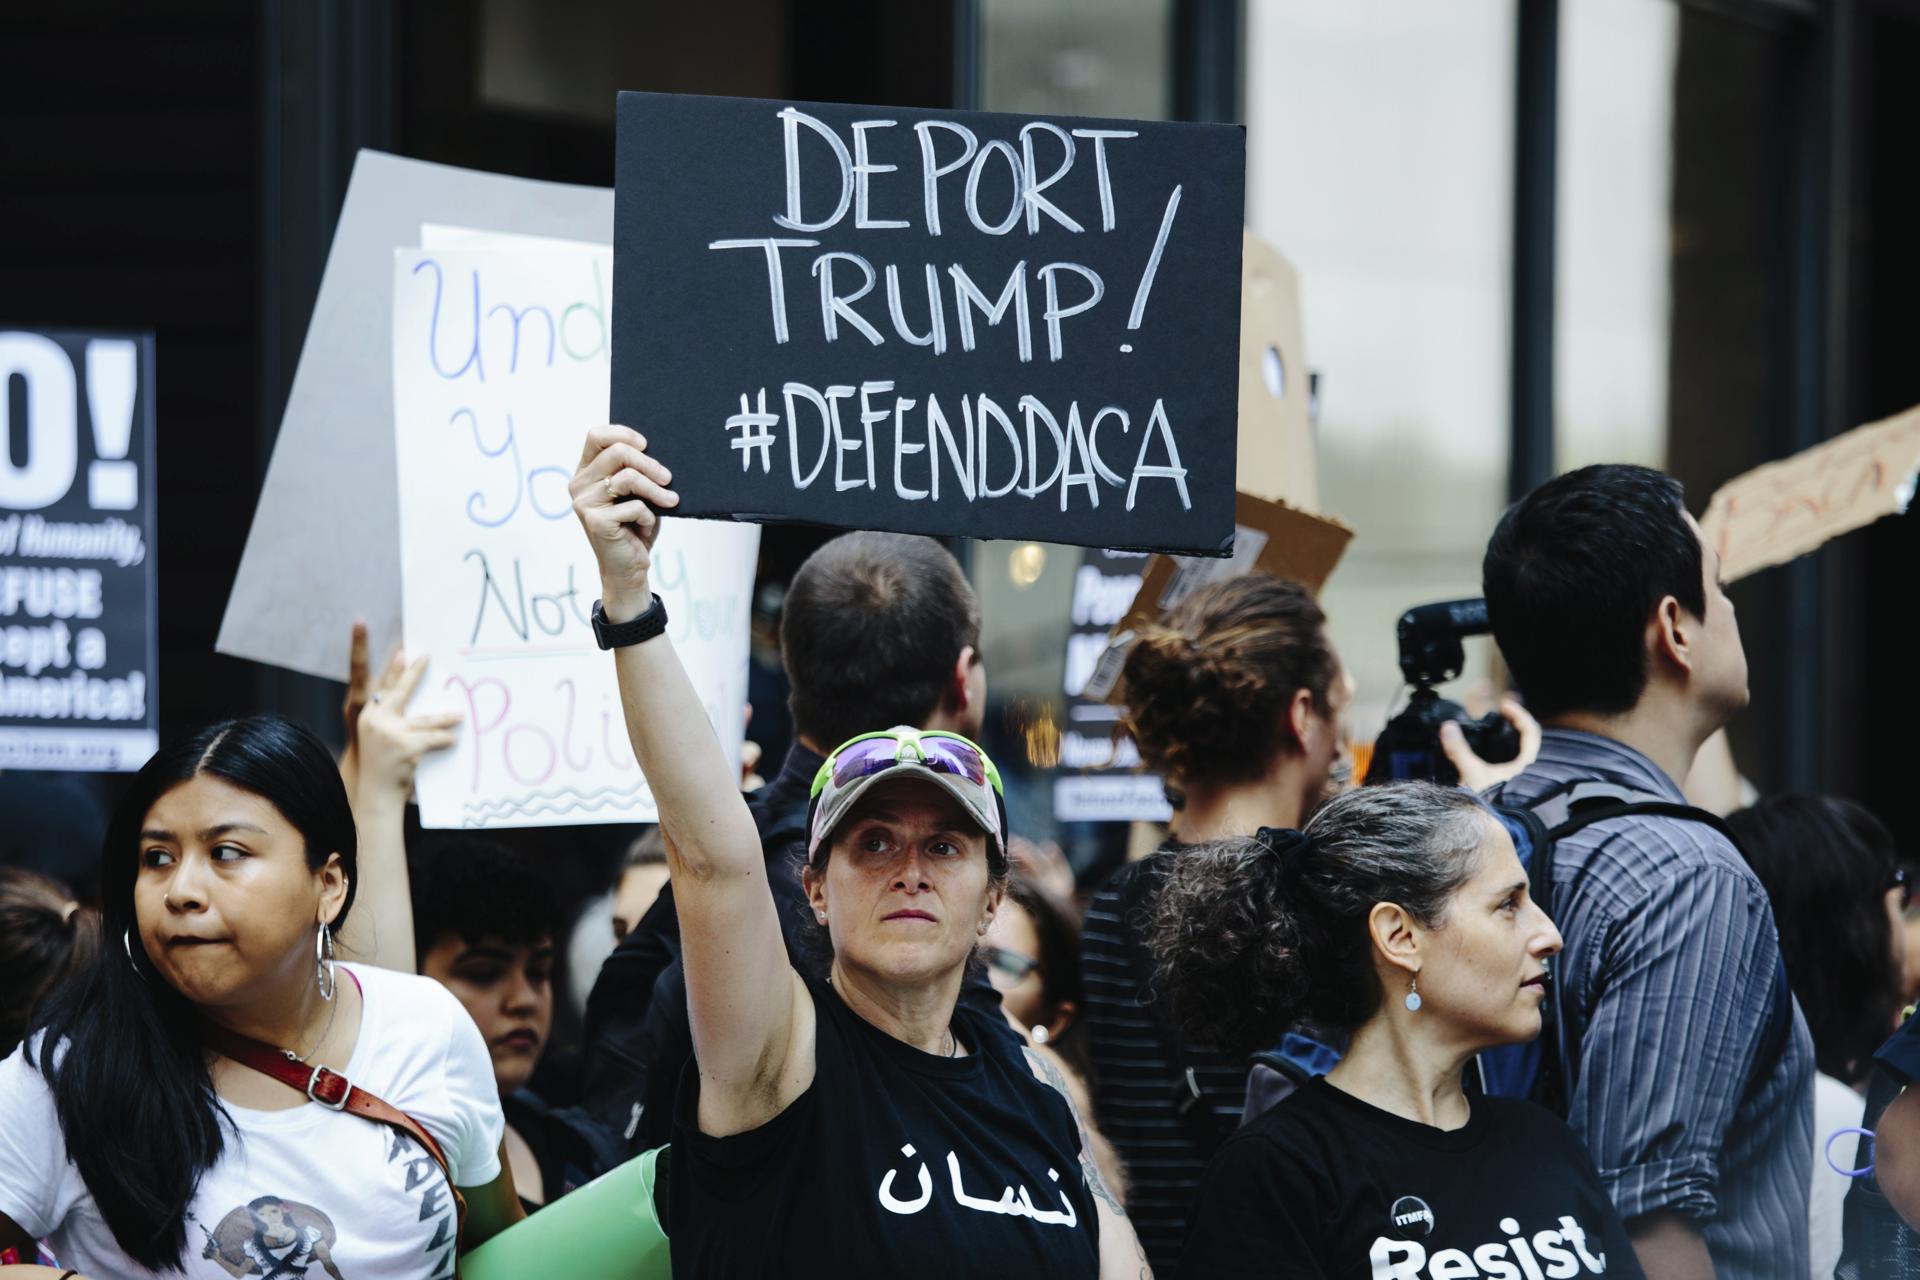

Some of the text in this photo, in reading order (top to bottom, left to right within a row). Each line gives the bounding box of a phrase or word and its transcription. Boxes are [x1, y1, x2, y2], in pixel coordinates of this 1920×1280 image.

[772, 107, 1139, 236] DEPORT
[725, 381, 1191, 511] #DEFENDDACA
[0, 565, 103, 619] FUSE
[464, 549, 593, 646] Not
[0, 619, 107, 676] ept a
[0, 669, 146, 721] merica!
